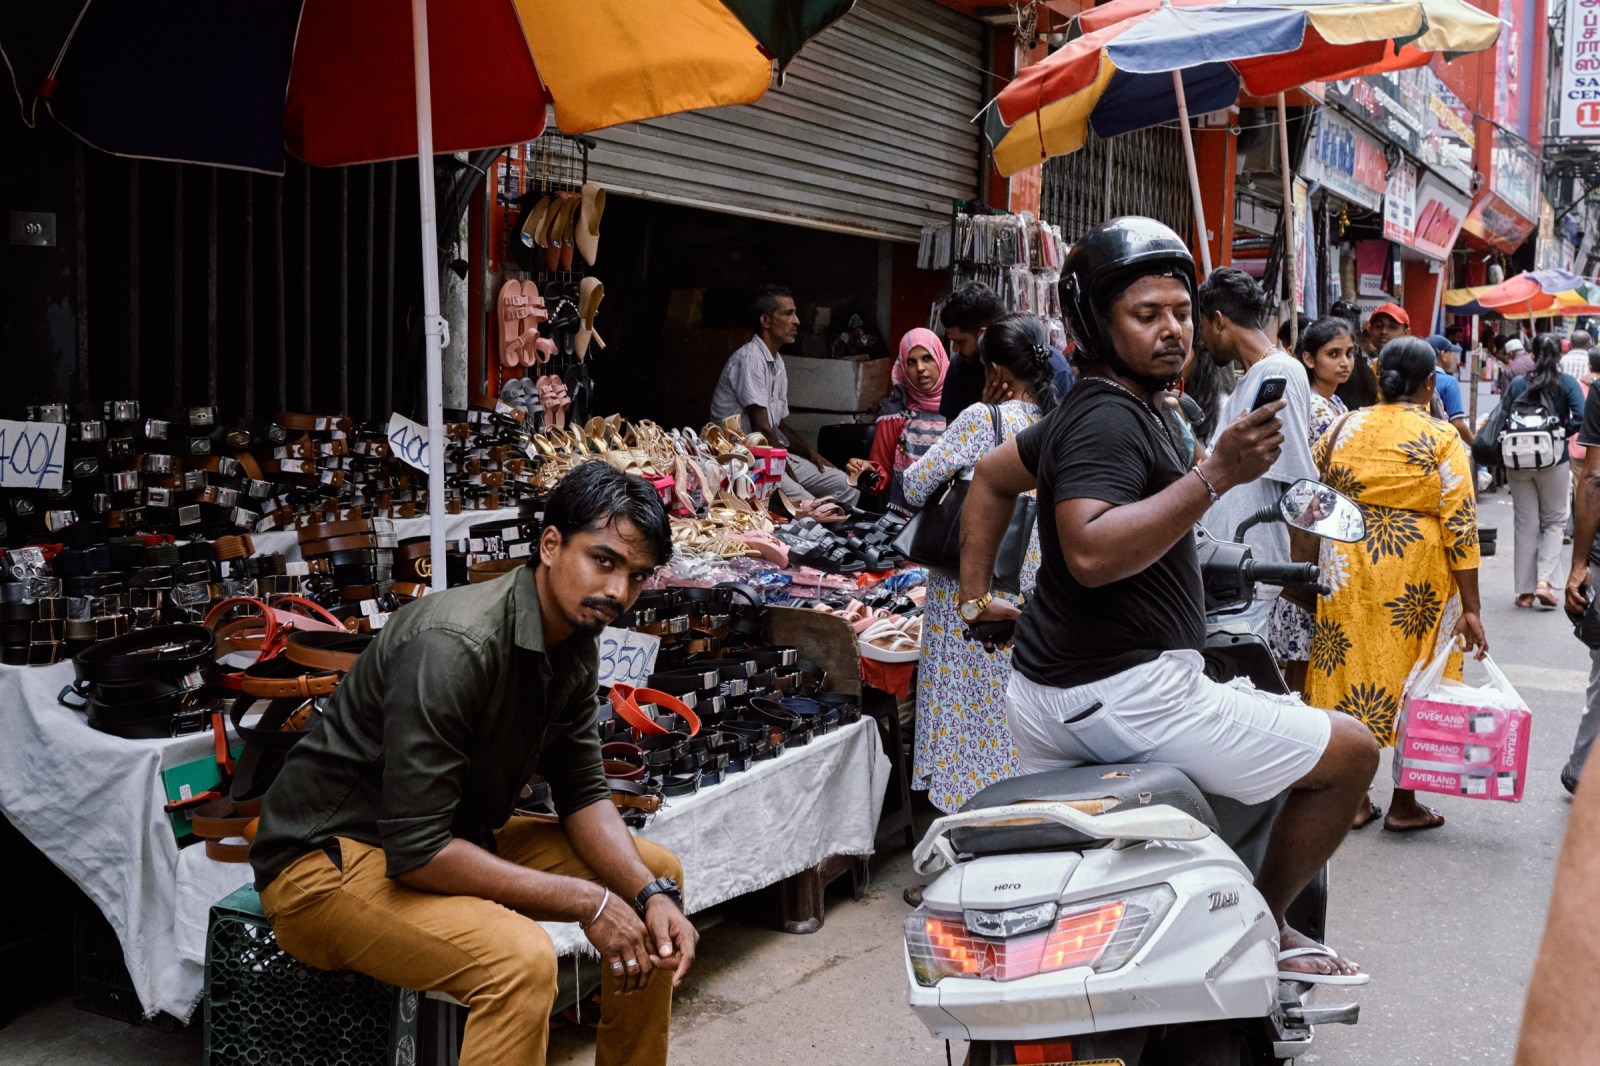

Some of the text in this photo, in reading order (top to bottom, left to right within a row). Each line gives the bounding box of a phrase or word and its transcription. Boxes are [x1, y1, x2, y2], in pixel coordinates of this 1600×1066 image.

[1416, 711, 1464, 724] OVERLAND
[1412, 742, 1460, 754] OVERLAND
[1506, 719, 1518, 767] OVERLAND
[1409, 772, 1456, 785] OVERLAND
